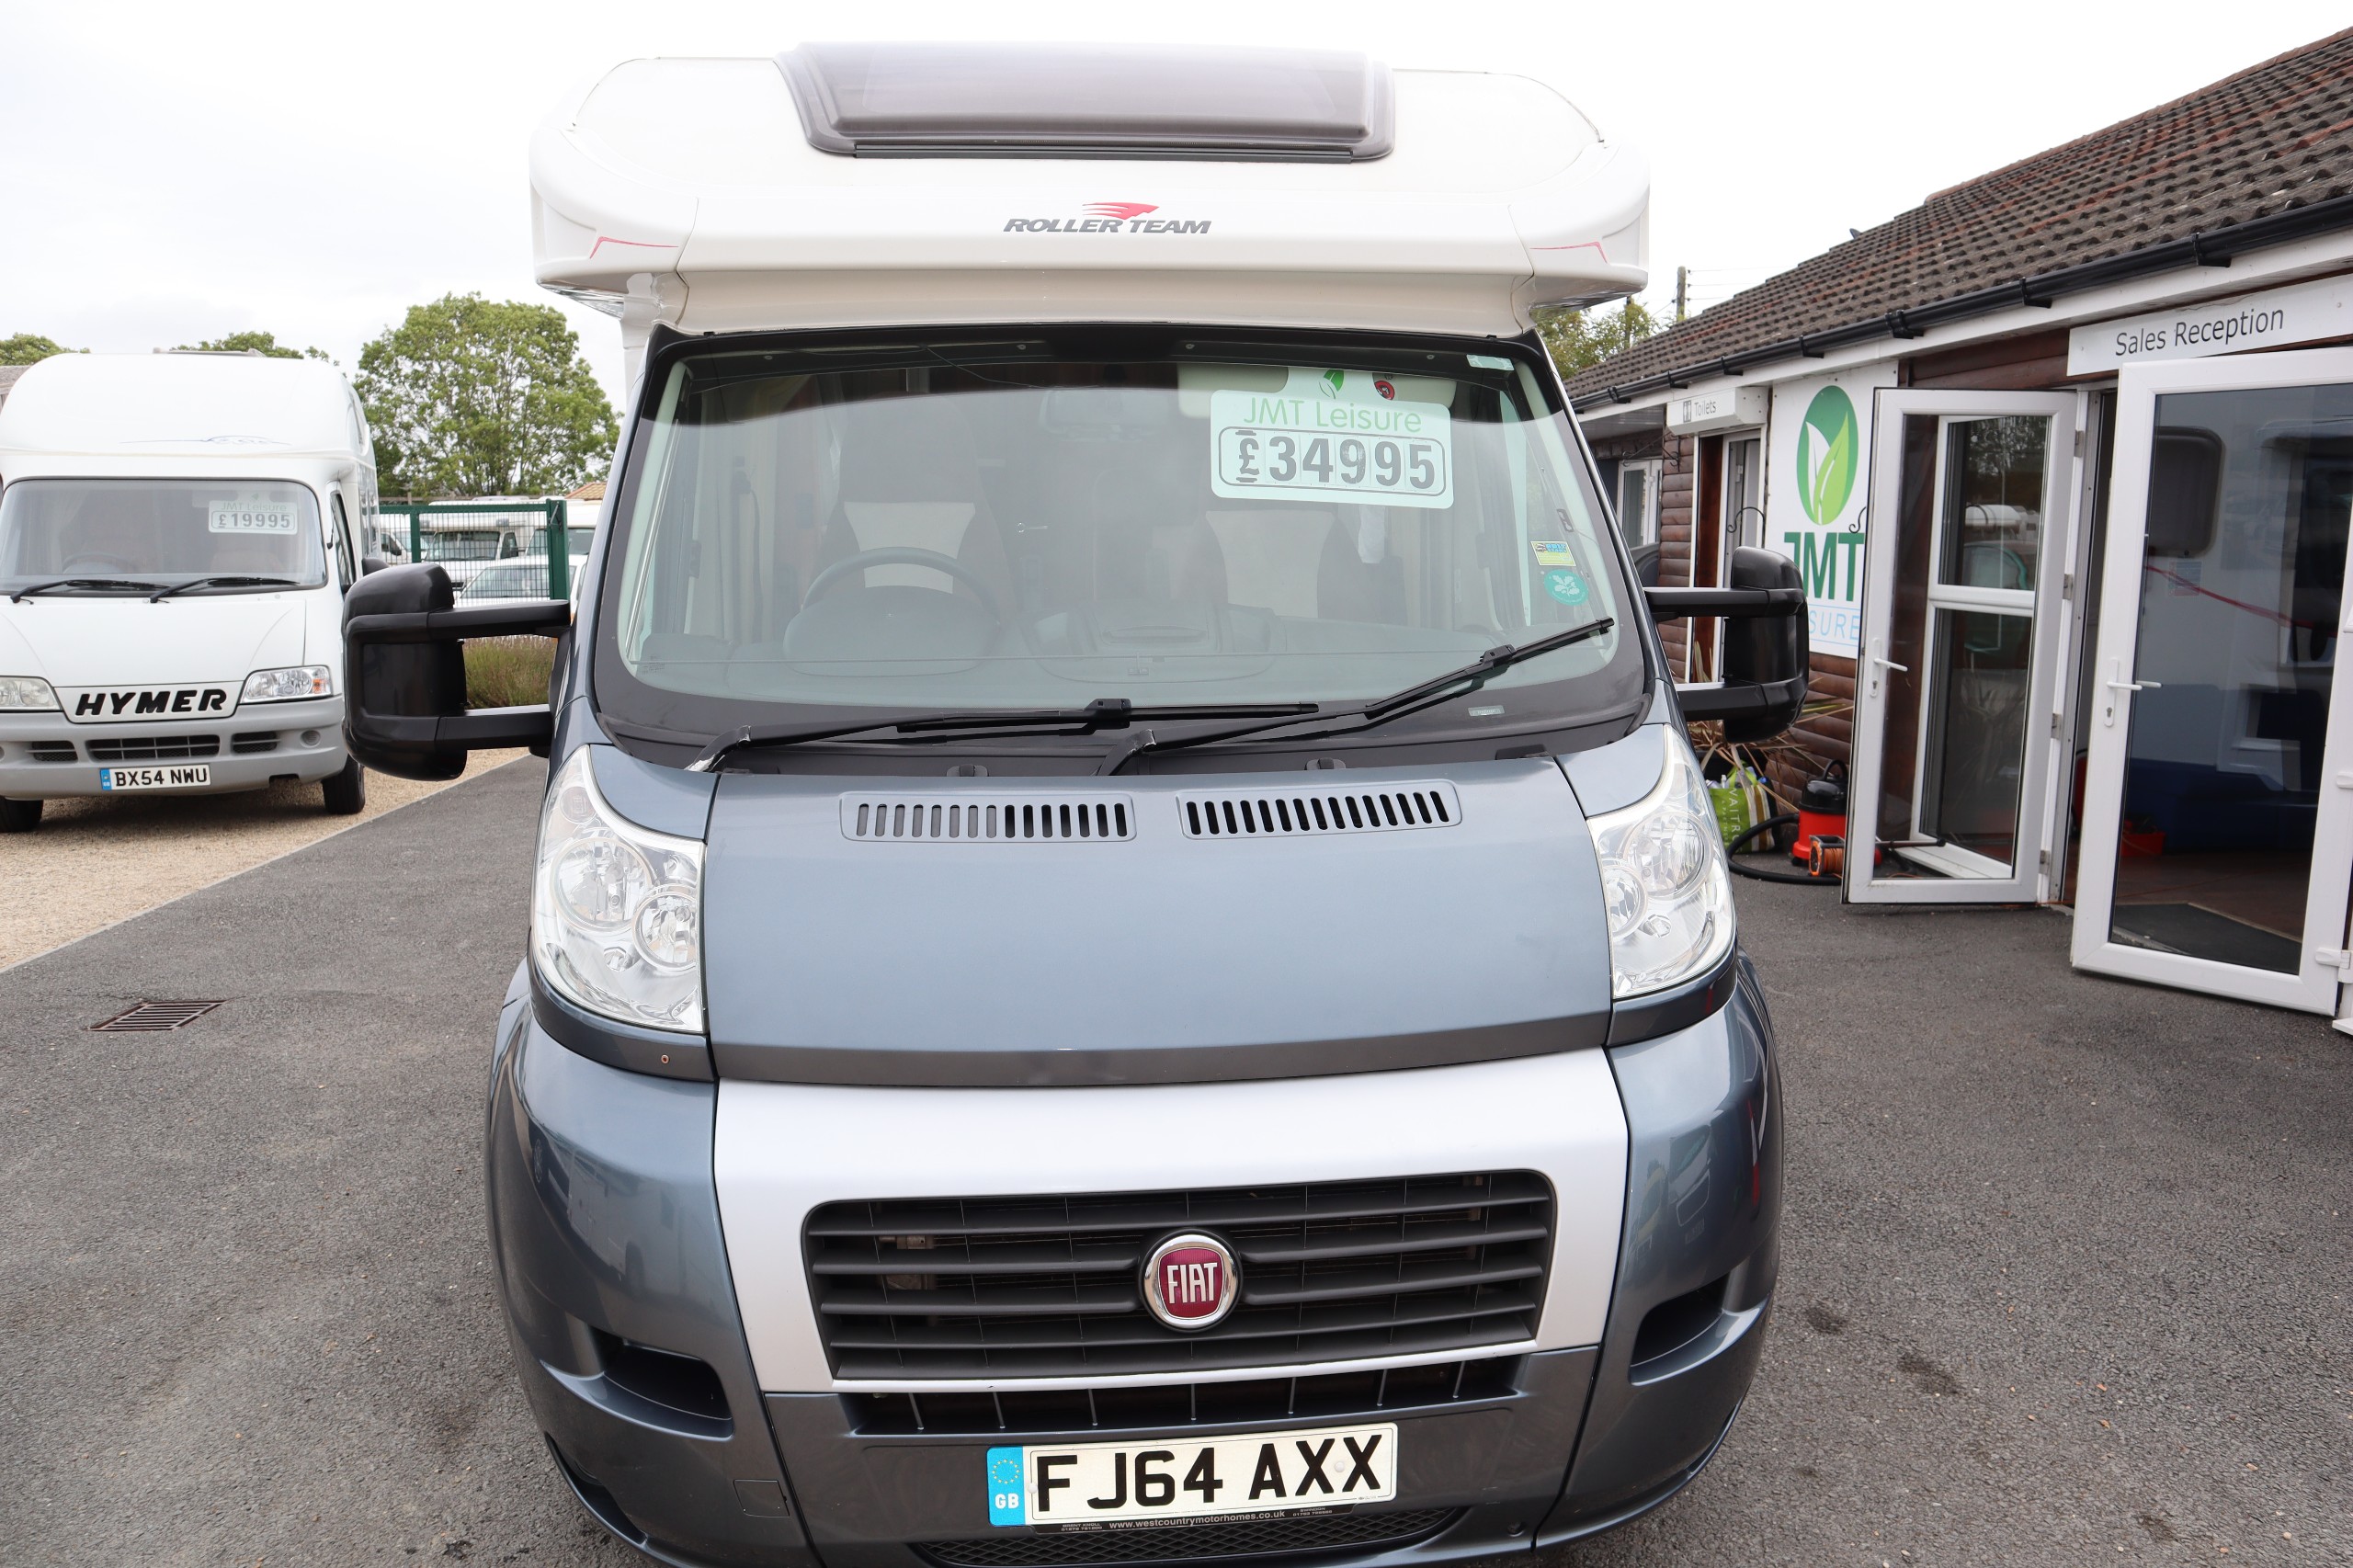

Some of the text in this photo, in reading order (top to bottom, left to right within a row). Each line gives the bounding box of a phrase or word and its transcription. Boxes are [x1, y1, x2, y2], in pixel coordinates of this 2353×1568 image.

[1003, 218, 1212, 234] ROLLER TEAM
[2115, 308, 2284, 357] Sales Reception
[1244, 397, 1422, 433] JMT Leisure
[1694, 400, 1717, 416] Toilets
[1237, 436, 1436, 490] £34995
[218, 513, 290, 528] £19995
[221, 502, 287, 513] JMT Leisure
[1783, 531, 1865, 602] JMT
[1809, 609, 1860, 641] SURE
[74, 688, 227, 716] HYMER
[115, 769, 165, 787] BX54
[170, 767, 208, 784] NWU
[1166, 1262, 1218, 1304] FIAT
[995, 1434, 1382, 1513] GB FJ64 AXX
[1108, 1510, 1286, 1530] www.westcountrymotorhomes.co.uk
